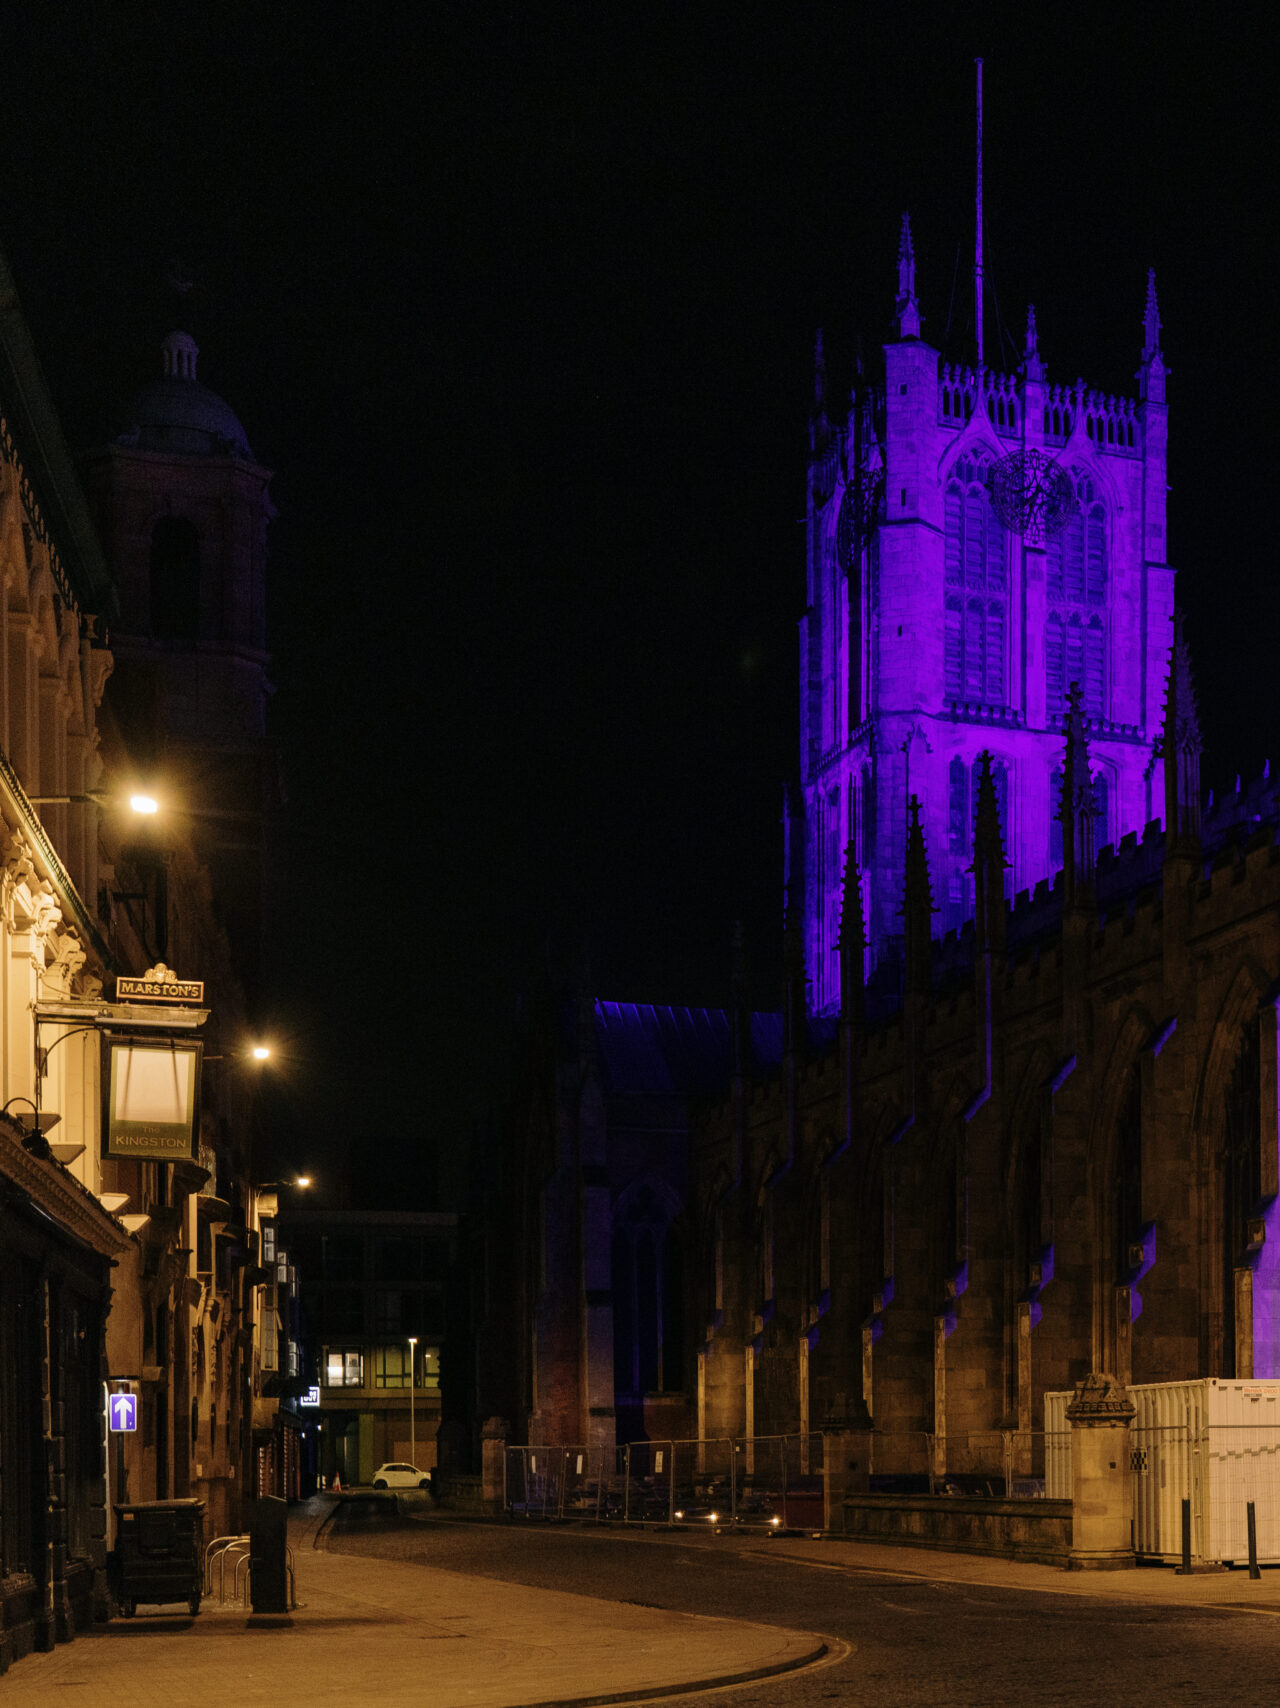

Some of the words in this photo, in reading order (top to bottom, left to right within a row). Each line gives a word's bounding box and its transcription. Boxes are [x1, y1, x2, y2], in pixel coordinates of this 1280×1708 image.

[121, 981, 199, 997] MARSTON'S
[143, 1125, 160, 1134] The
[115, 1135, 186, 1149] KINGSTON
